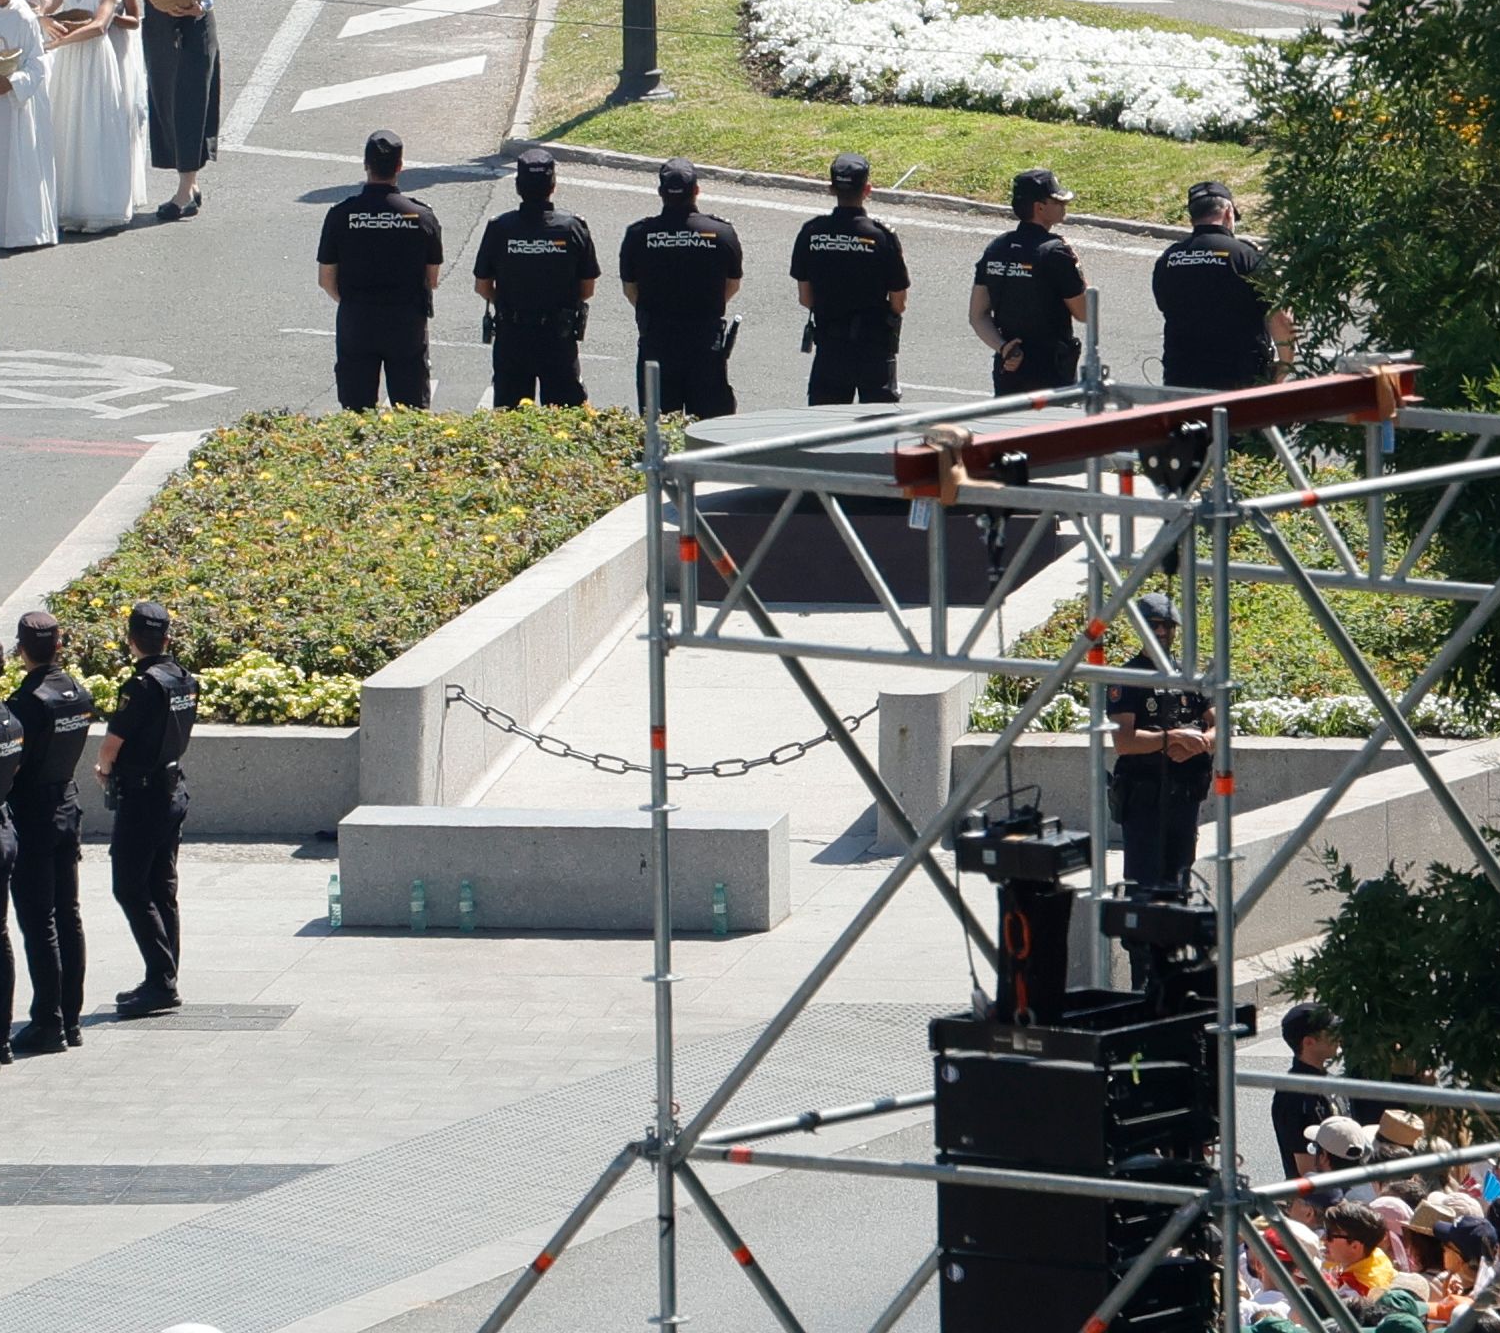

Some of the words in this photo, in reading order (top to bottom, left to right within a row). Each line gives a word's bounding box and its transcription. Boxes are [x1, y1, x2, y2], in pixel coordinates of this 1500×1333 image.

[348, 212, 404, 222] POLICIA
[348, 220, 419, 230] NACIONAL
[647, 230, 701, 240] POLICIA
[810, 233, 860, 244] POLICIA
[507, 239, 556, 248] POLICIA
[646, 239, 717, 249] NACIONAL
[809, 241, 875, 253] NACIONAL
[507, 246, 567, 254] NACIONAL
[1168, 250, 1215, 260] POLICIA
[1166, 256, 1227, 267] NACIONAL
[54, 719, 91, 733] NACIONAL
